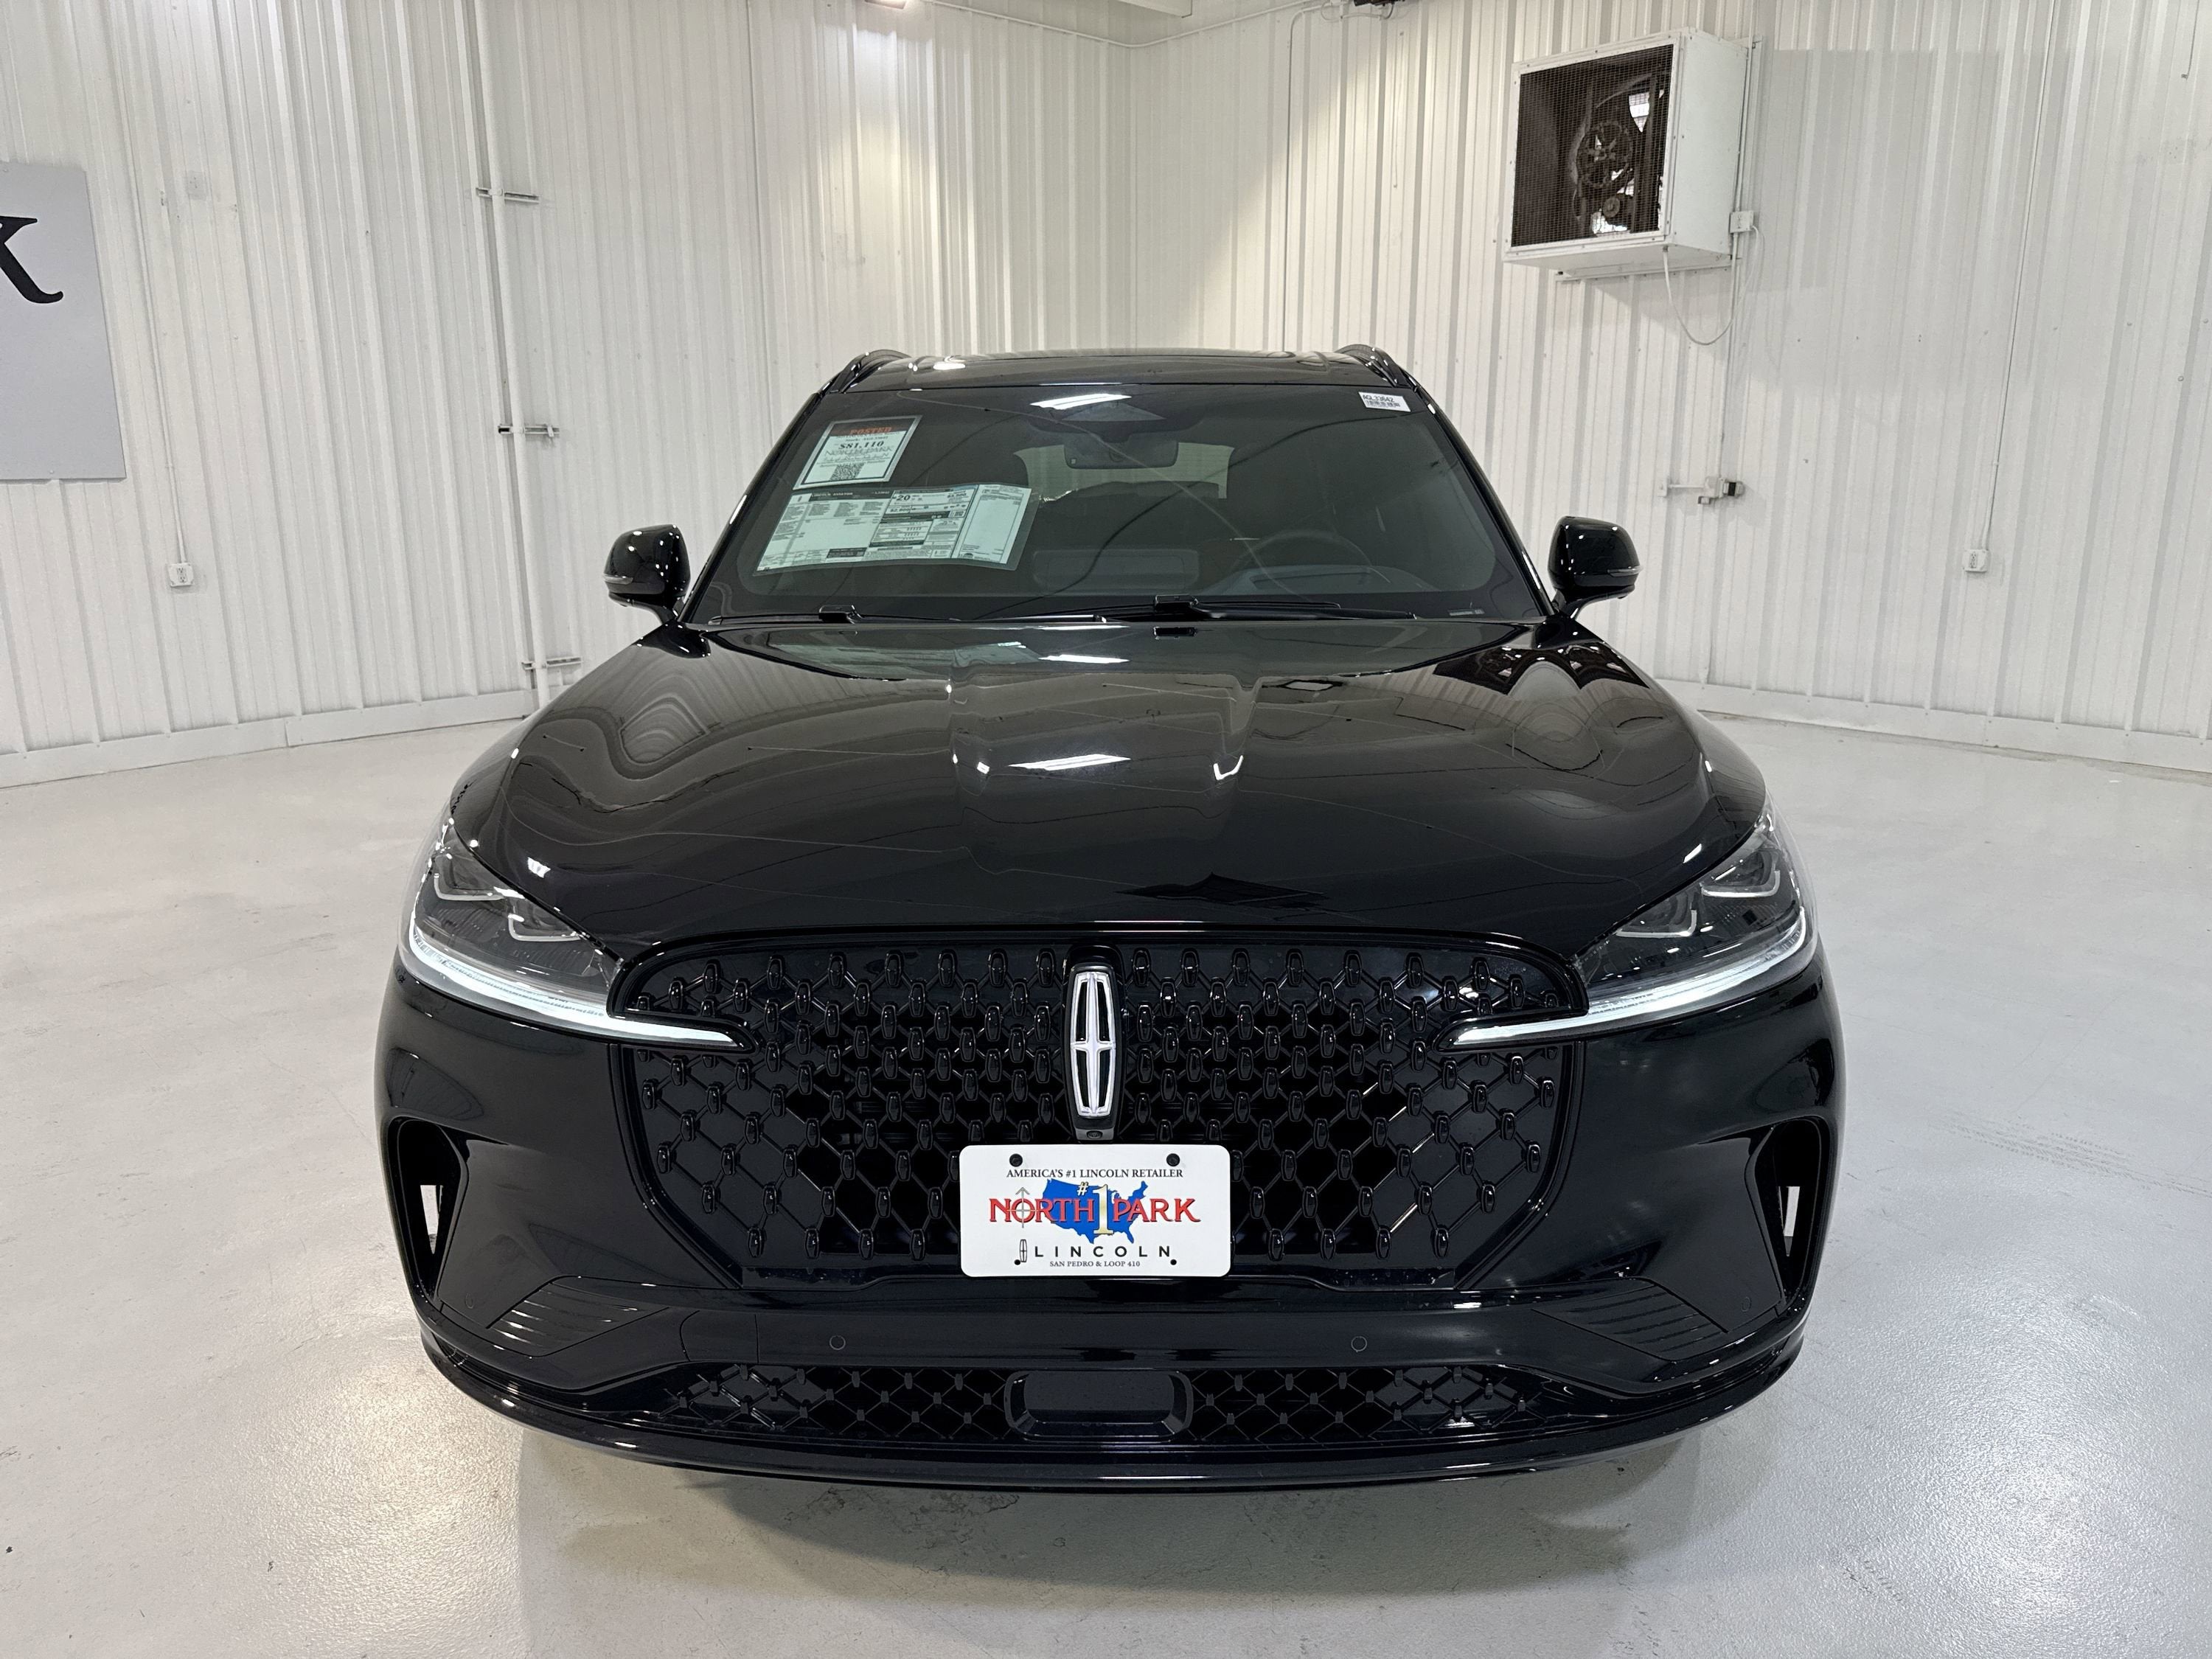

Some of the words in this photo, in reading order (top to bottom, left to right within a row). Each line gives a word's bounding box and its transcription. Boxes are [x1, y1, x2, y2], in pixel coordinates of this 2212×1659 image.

[849, 427, 892, 435] POSTED
[1006, 1169, 1063, 1178] AMERICA'S
[1065, 1169, 1077, 1178] #1
[1079, 1169, 1130, 1178] LINCOLN
[1131, 1169, 1183, 1178] RETAILER
[989, 1197, 1095, 1223] NORTH
[1113, 1197, 1201, 1223] PARK
[1034, 1245, 1170, 1258] LINCOLN
